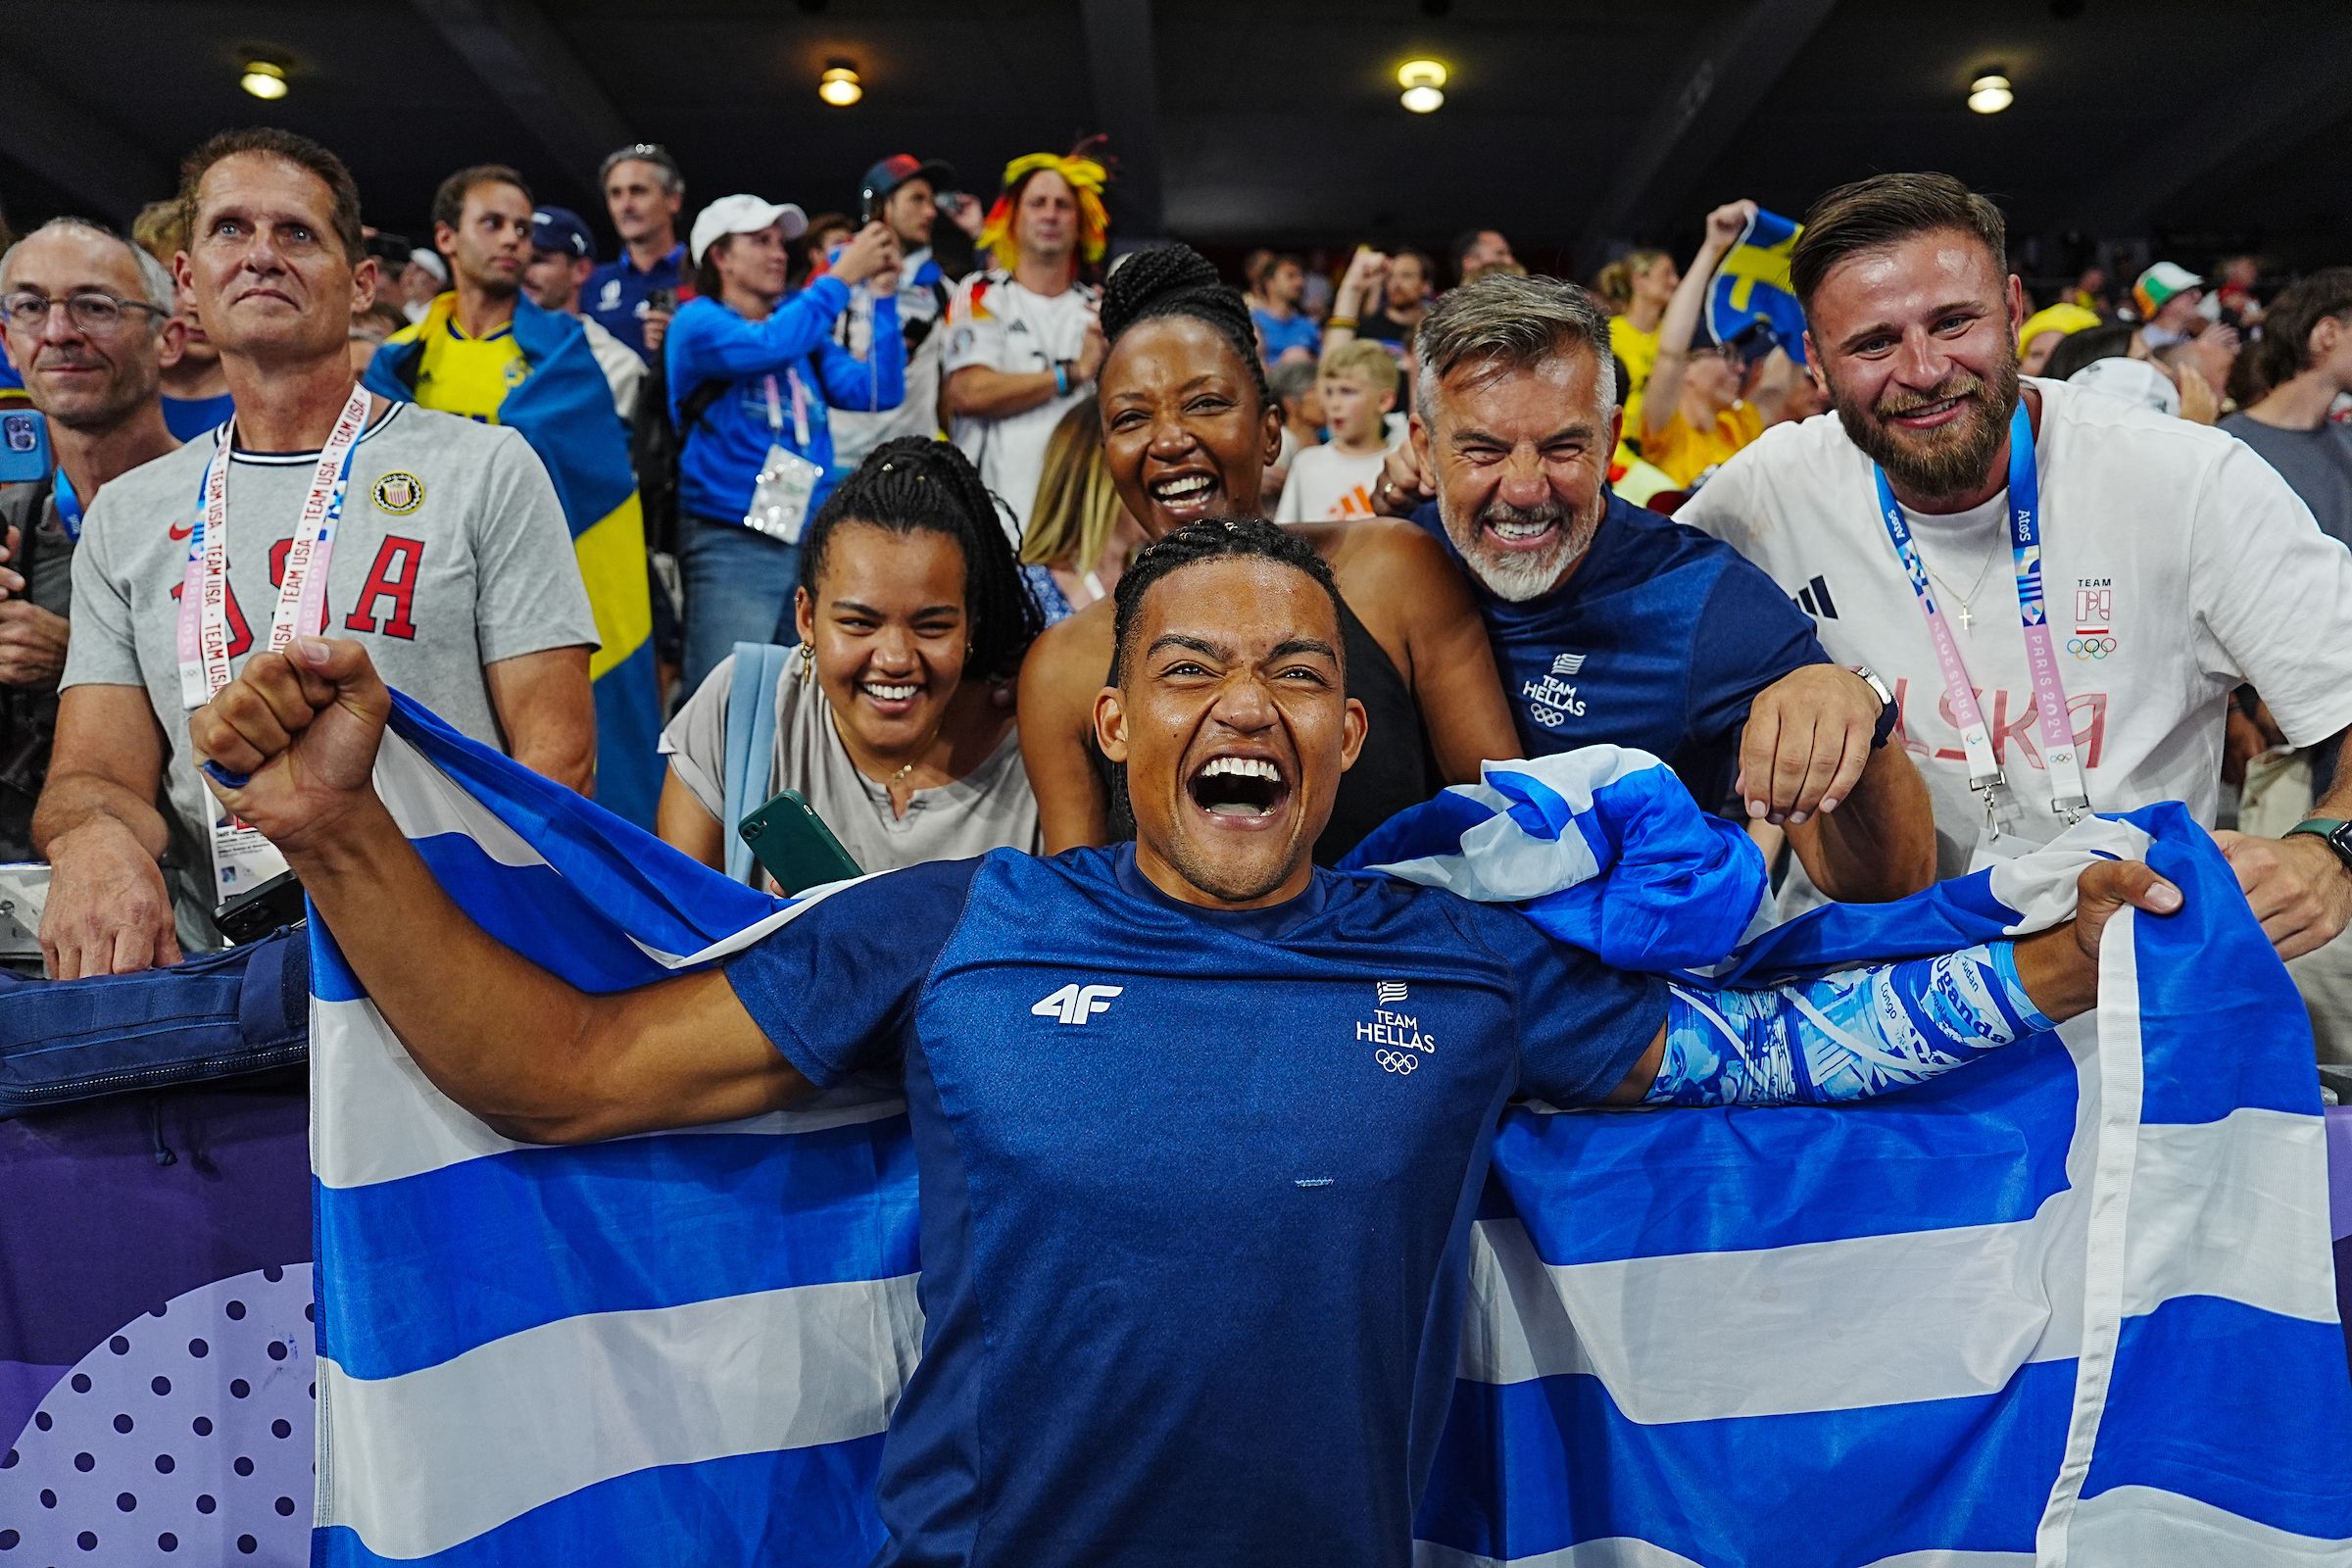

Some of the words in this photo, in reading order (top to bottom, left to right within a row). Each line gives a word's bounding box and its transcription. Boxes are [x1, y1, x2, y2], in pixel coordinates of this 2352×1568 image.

[351, 399, 367, 422] USA
[330, 421, 358, 448] TEAM
[210, 470, 224, 500] TEAM
[317, 462, 338, 487] USA
[208, 501, 222, 530] USA
[305, 490, 326, 521] TEAM
[1887, 509, 1906, 539] Atos
[2018, 510, 2032, 542] Atos
[206, 544, 222, 575] TEAM
[292, 539, 312, 568] USA
[204, 580, 220, 608] USA
[281, 570, 305, 605] TEAM
[2078, 578, 2112, 588] TEAM
[205, 623, 224, 661] TEAM
[1522, 680, 1587, 717] HELLAS
[1544, 674, 1577, 698] TEAM
[1949, 669, 1973, 720] PARIS
[2041, 692, 2063, 739] 2024
[1031, 983, 1124, 1025] 4F
[1880, 982, 1897, 1019] Congo
[1936, 954, 2007, 1044] Uganda
[1374, 1008, 1418, 1031] TEAM
[1356, 1020, 1436, 1054] HELLAS
